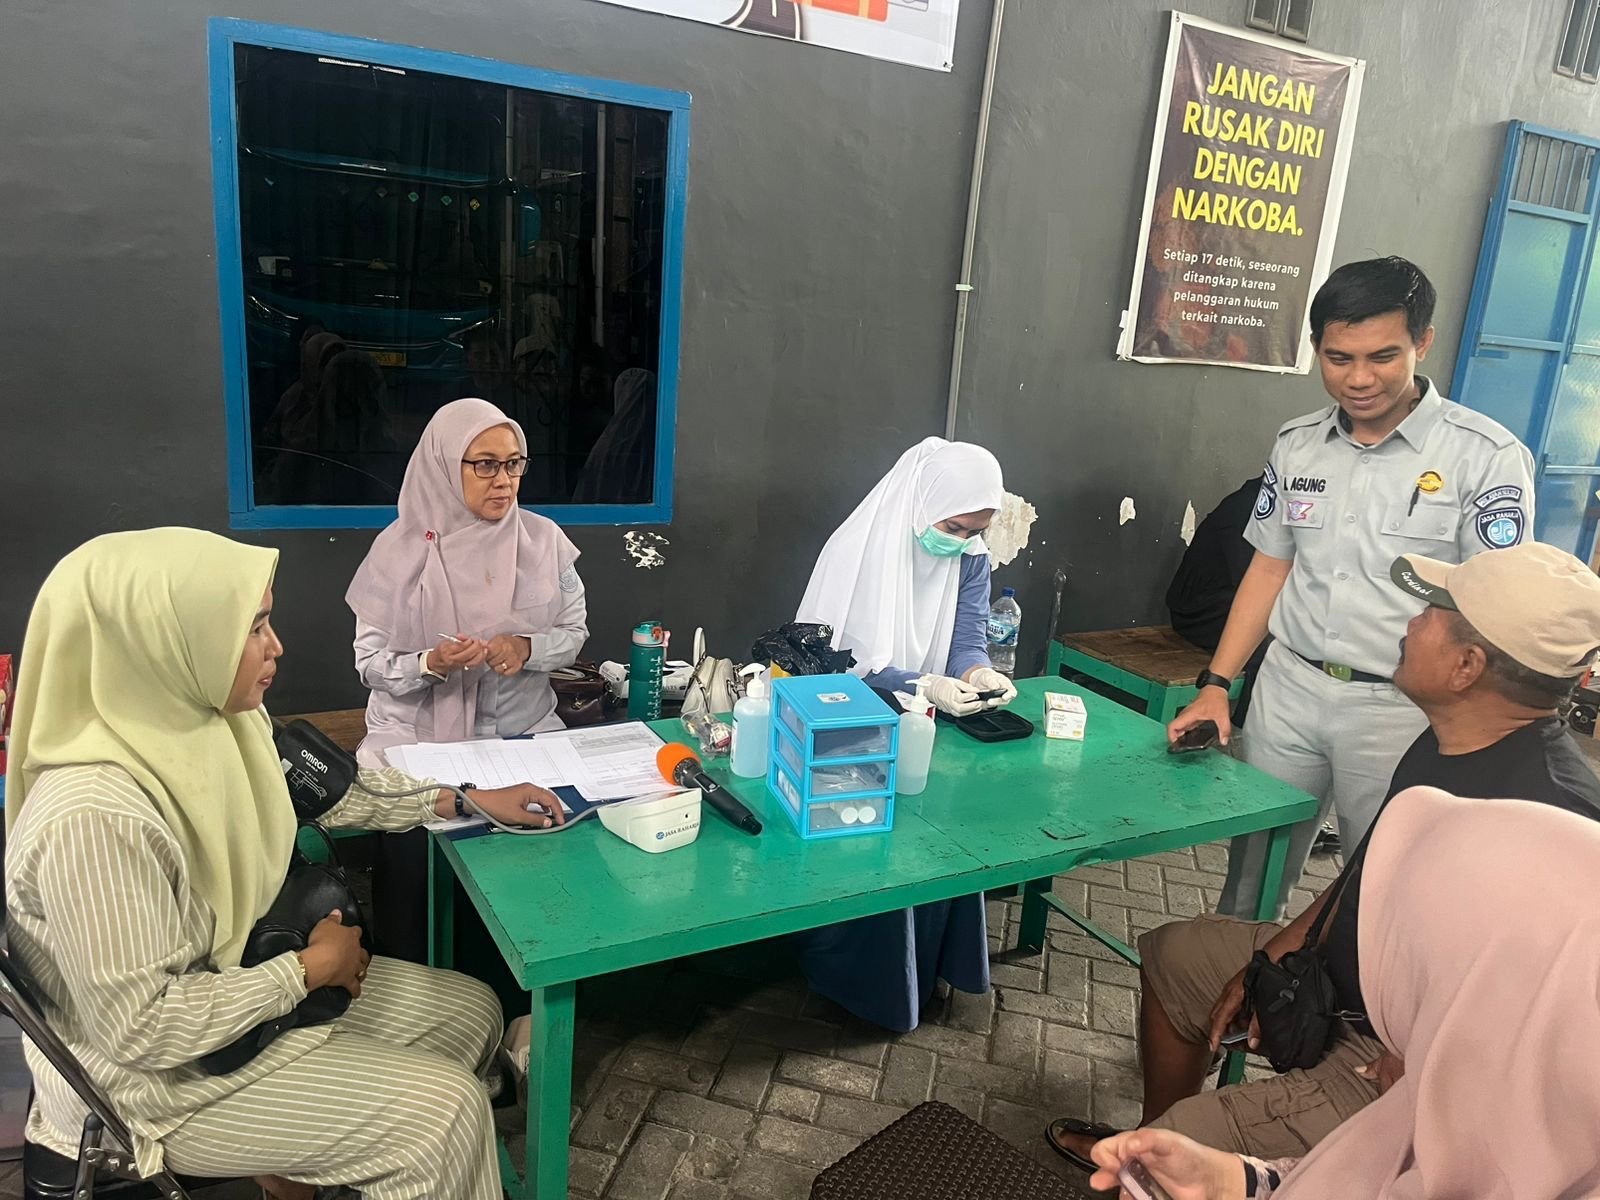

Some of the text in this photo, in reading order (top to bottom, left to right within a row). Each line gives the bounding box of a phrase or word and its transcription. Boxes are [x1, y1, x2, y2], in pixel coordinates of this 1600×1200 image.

[1207, 62, 1316, 115] JANGAN
[1182, 100, 1325, 159] RUSAK DIRI
[1193, 147, 1302, 195] DENGAN
[1171, 187, 1304, 236] NARKOBA.
[1163, 248, 1300, 278] Setiap 17 detik, seseorang
[1183, 271, 1276, 291] ditangkap karena
[1173, 291, 1280, 310] pelanggaran hukum
[1181, 310, 1266, 328] terkait narkoba.
[1290, 477, 1326, 493] AGUNG
[1481, 513, 1496, 524] JASA
[301, 749, 328, 774] OMRON
[665, 830, 677, 838] JASA
